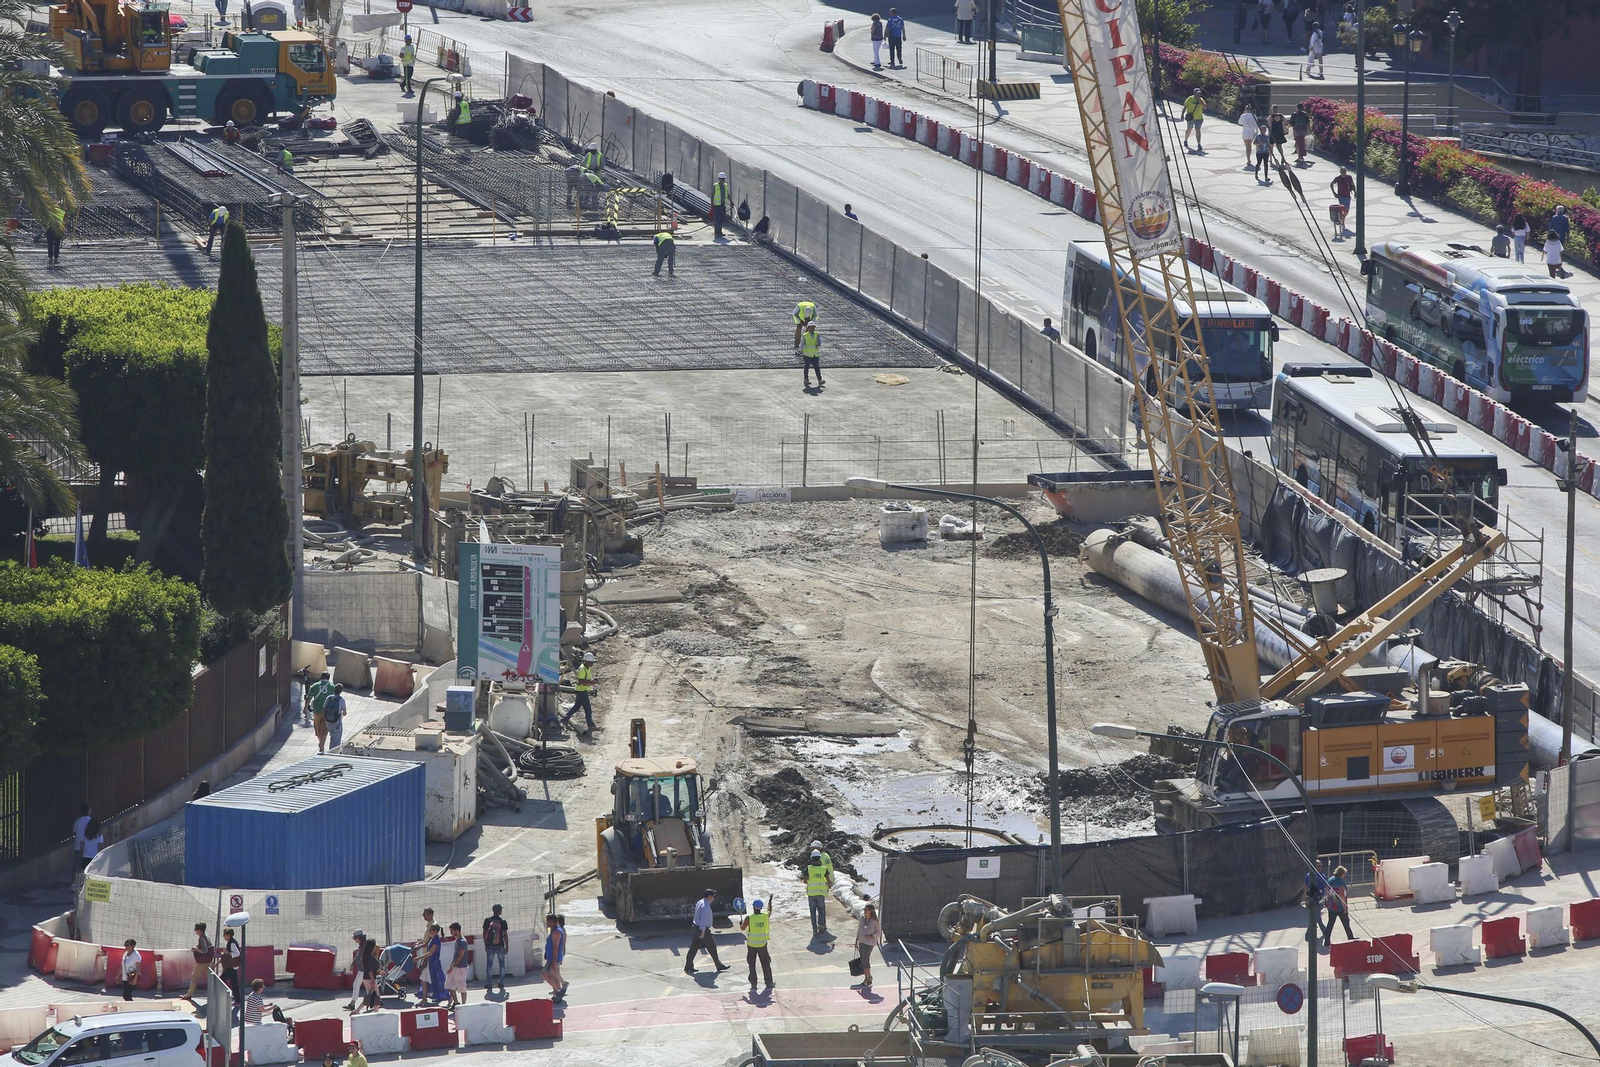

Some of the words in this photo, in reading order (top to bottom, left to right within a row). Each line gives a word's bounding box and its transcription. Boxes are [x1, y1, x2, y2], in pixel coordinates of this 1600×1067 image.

[1508, 355, 1544, 364] eléctrico
[1418, 766, 1485, 781] LIEBHERR
[1366, 954, 1384, 964] STOP
